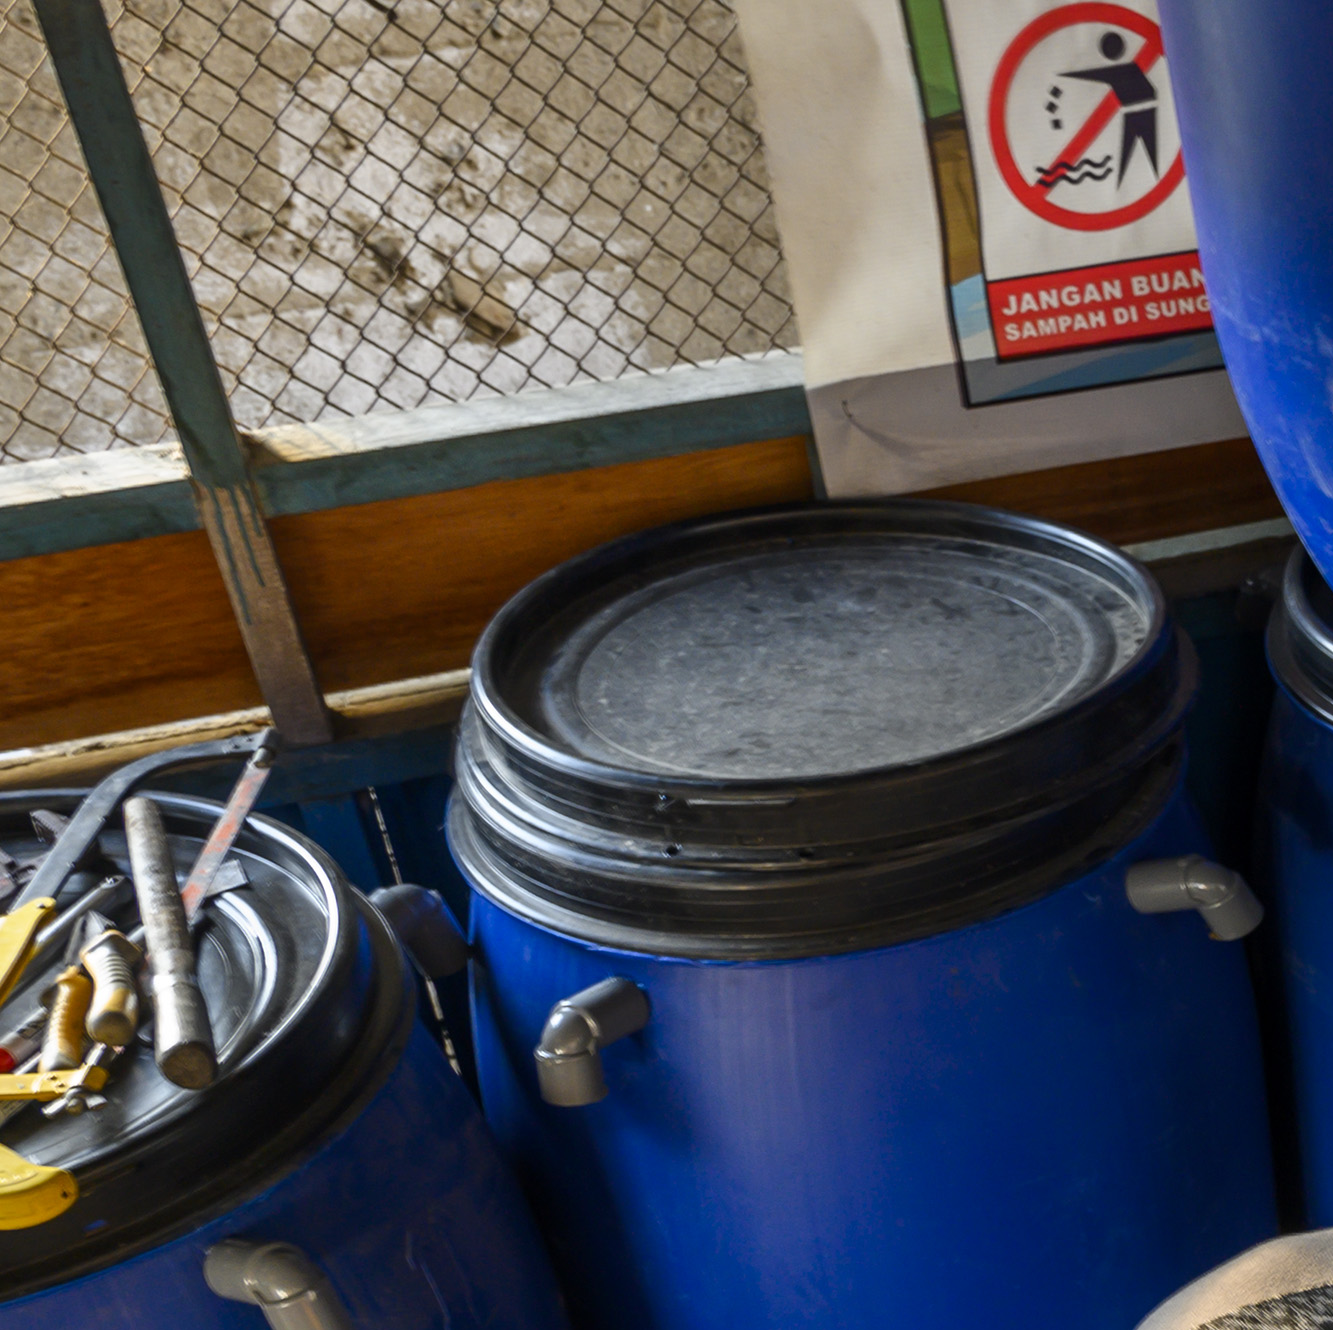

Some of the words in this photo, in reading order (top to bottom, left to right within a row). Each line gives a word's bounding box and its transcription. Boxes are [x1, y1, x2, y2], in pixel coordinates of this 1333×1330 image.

[1003, 279, 1123, 316] JANGAN
[1005, 310, 1106, 341] SAMPAH
[1113, 305, 1138, 326] DI
